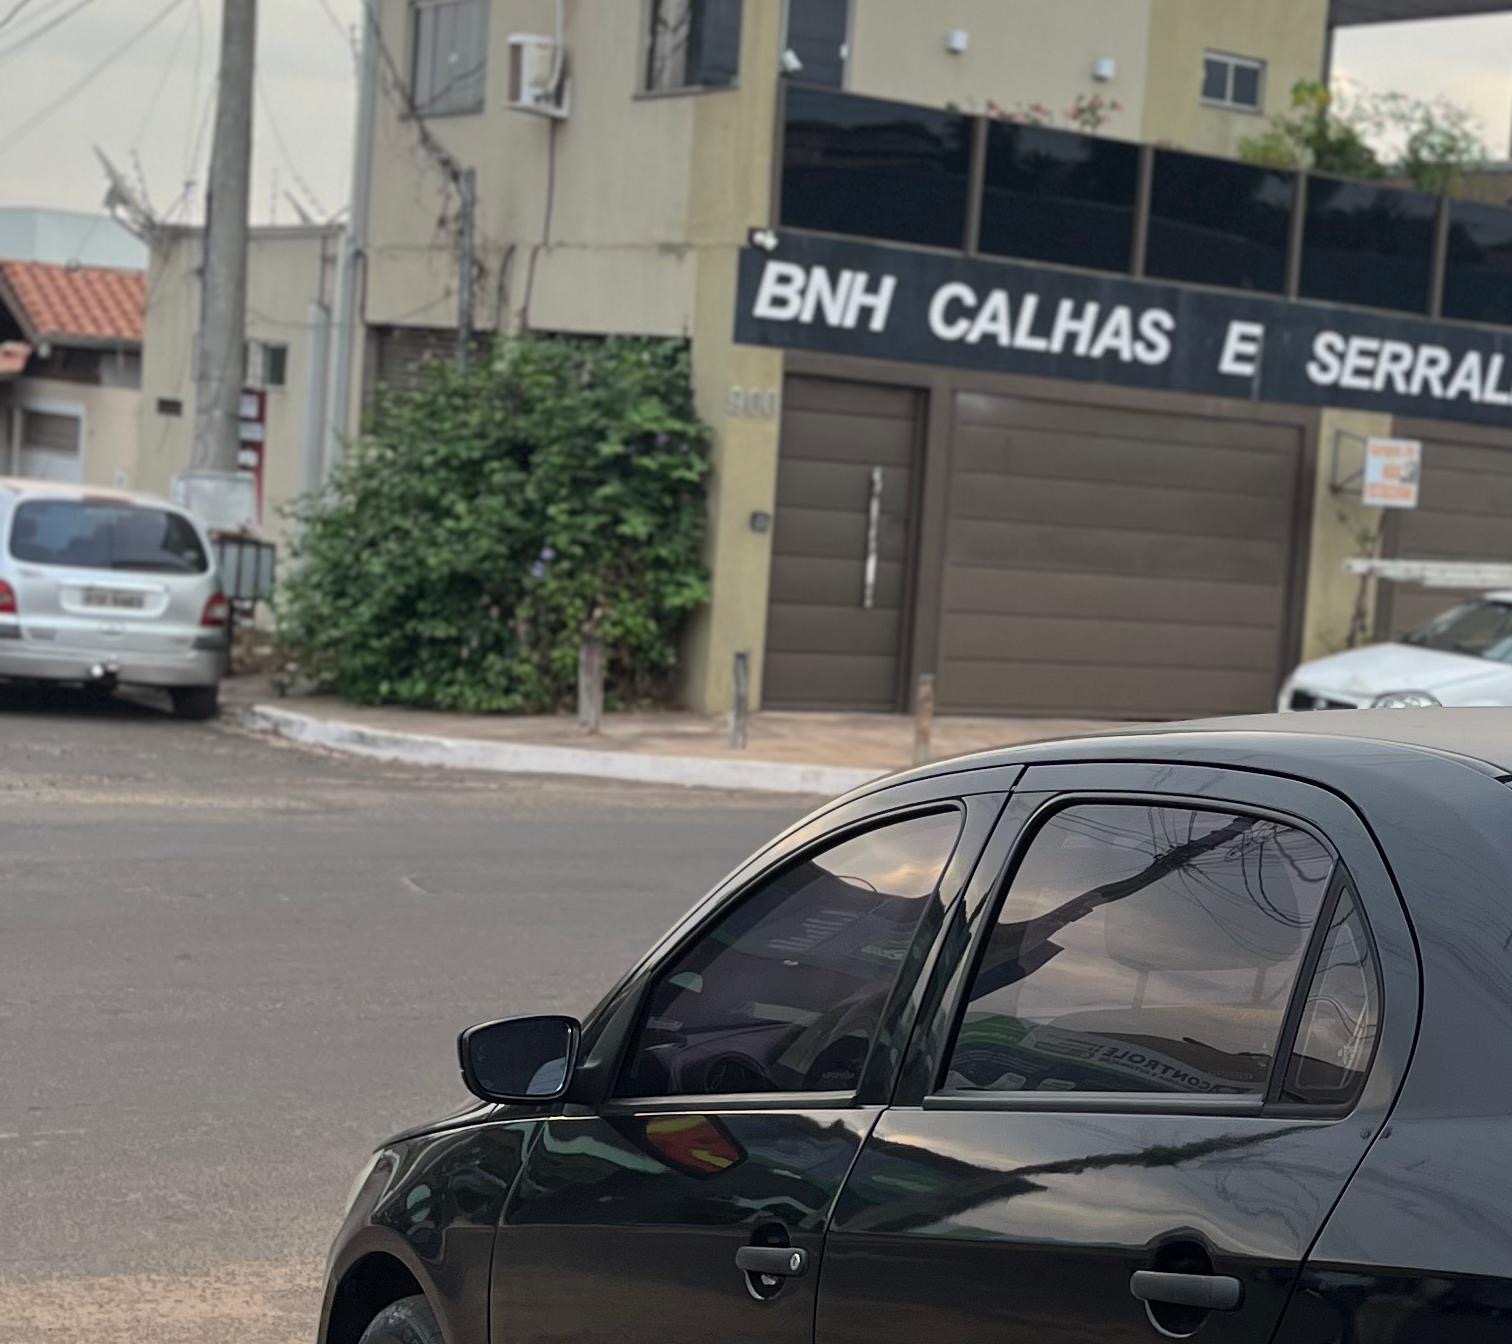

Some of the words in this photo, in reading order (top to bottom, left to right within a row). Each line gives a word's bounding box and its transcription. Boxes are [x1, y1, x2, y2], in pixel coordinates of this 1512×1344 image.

[753, 260, 896, 332] BNH
[929, 282, 1176, 365] CALHAS
[1218, 320, 1264, 376] E
